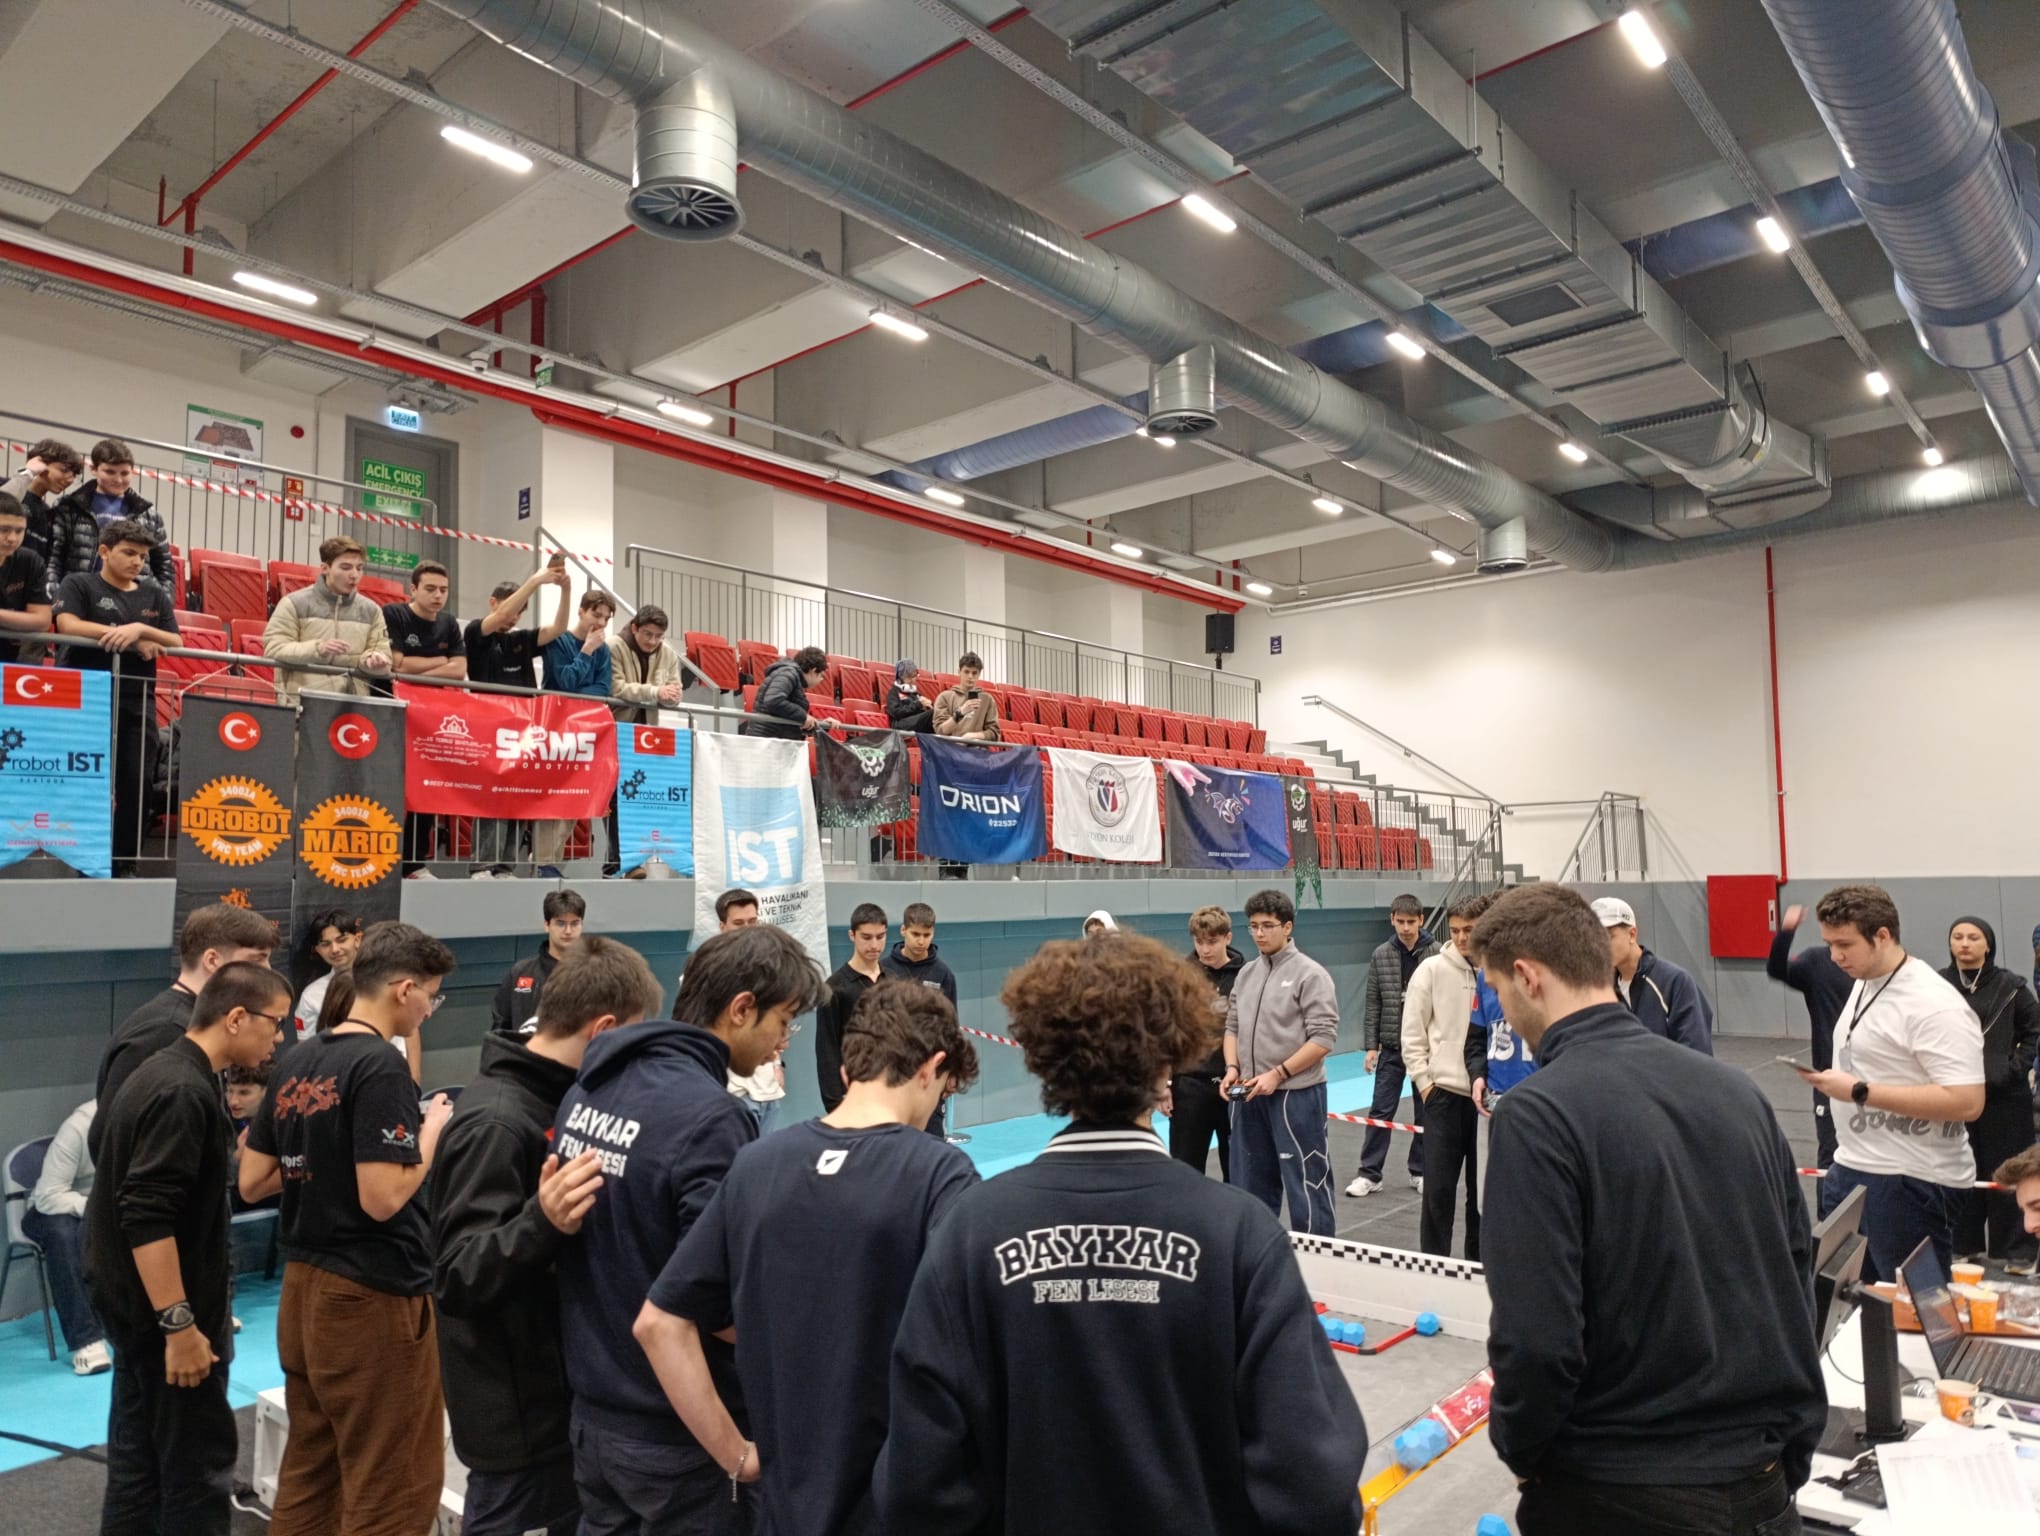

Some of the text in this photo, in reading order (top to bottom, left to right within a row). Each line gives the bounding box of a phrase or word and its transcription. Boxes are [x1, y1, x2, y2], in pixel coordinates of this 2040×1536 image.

[393, 470, 422, 488] ÇIKIŞ
[11, 752, 105, 773] robot IST
[639, 787, 688, 802] robot IST
[940, 785, 1021, 815] ORION
[235, 838, 263, 857] TEAM
[304, 828, 398, 854] MARIO
[727, 827, 799, 883] IST
[565, 1102, 640, 1149] BAYKAR
[994, 1224, 1201, 1286] BAYKAR
[1033, 1279, 1083, 1303] FEN
